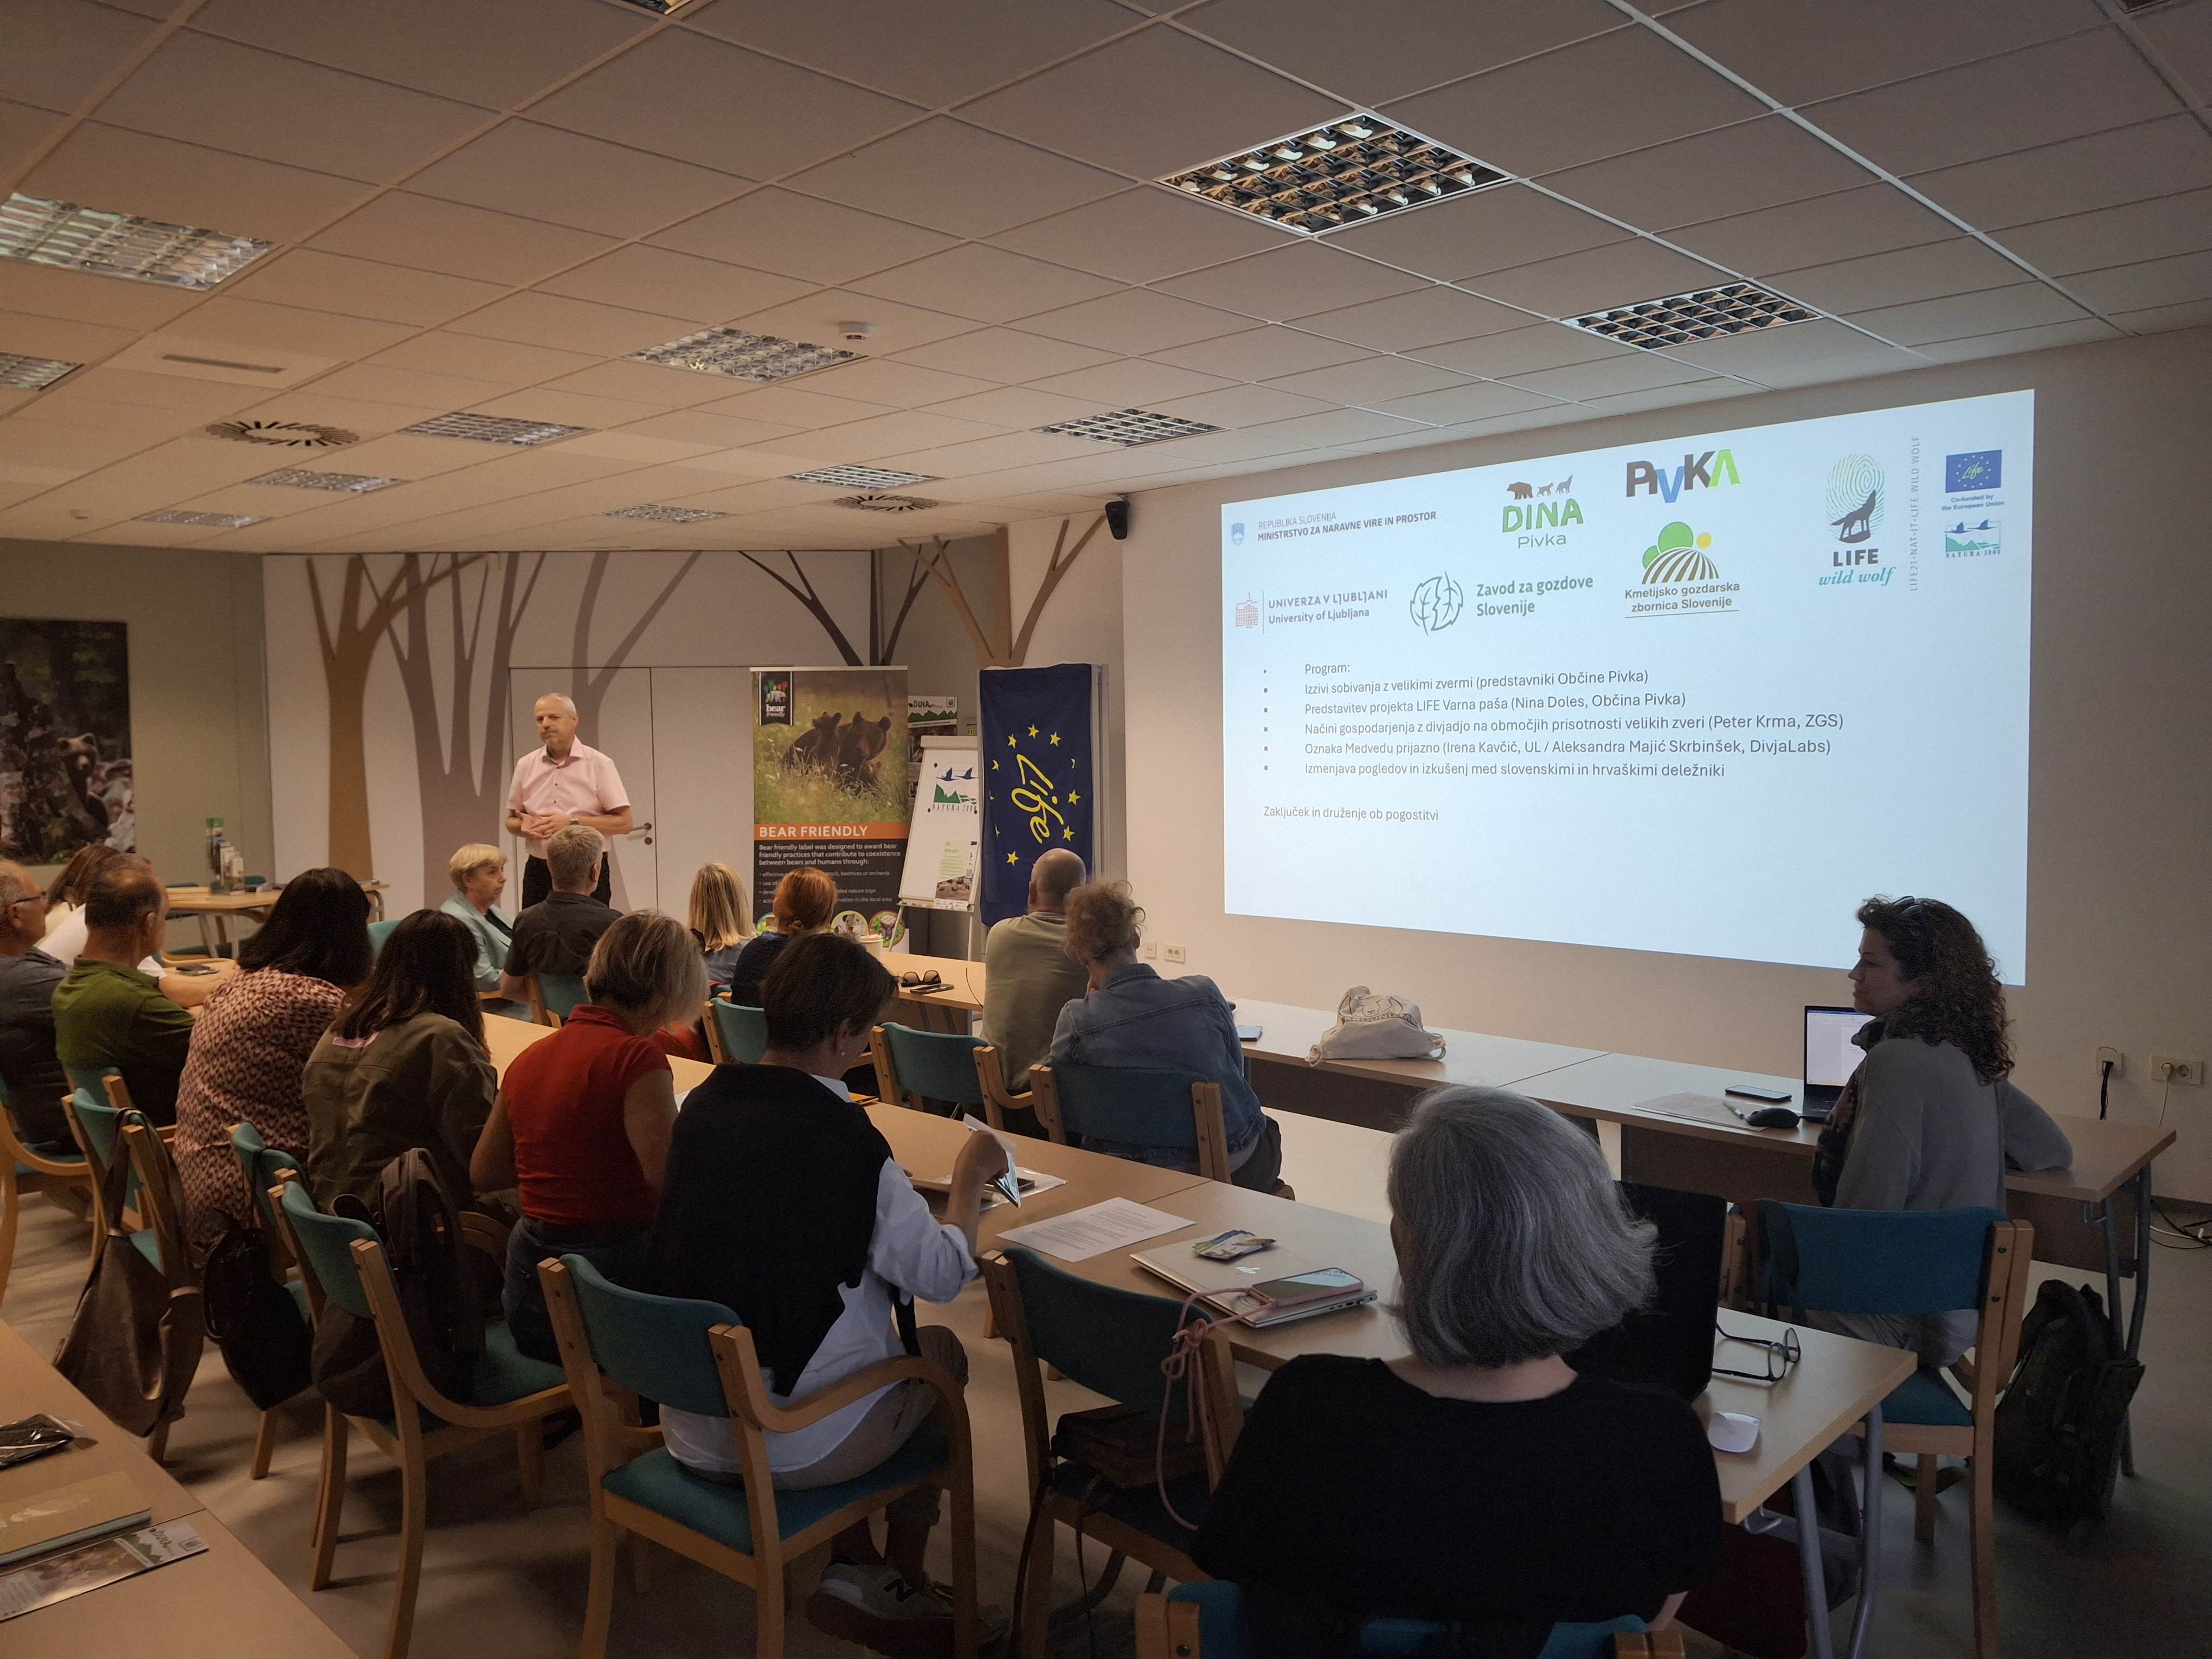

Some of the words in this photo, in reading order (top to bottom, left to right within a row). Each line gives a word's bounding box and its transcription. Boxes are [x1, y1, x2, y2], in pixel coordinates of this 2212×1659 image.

[1962, 462, 1983, 480] Life
[1911, 468, 1919, 493] WILD
[1950, 495, 1984, 503] Co-funded
[1258, 517, 1297, 530] REPUBLIKA
[1298, 512, 1336, 525] SLOVENIJA
[1502, 498, 1584, 533] DINA
[1258, 523, 1309, 541] MINISTRSTVO
[1310, 526, 1321, 535] ZA
[1322, 520, 1361, 533] NARAVNE
[1363, 517, 1383, 529] VIRE
[1385, 517, 1394, 525] IN
[1396, 511, 1436, 524] PROSTOR
[1517, 533, 1566, 549] Pivka
[1833, 548, 1879, 567] LIFE
[1818, 569, 1854, 586] wild
[1858, 566, 1896, 587] wolf
[1477, 580, 1515, 597] Zavod
[1519, 582, 1533, 594] za
[1536, 575, 1593, 596] gozdove
[1625, 587, 1678, 599] Kmetijsko
[1681, 582, 1740, 597] gozdarska
[1268, 595, 1321, 609] UNIVERZA
[1323, 594, 1330, 604] V
[1477, 599, 1535, 617] Slovenije
[1631, 601, 1678, 613] zbornica
[1681, 596, 1732, 609] Slovenije
[1268, 612, 1314, 624] University
[1315, 610, 1326, 621] of
[1328, 608, 1369, 622] Ljubljana
[1305, 664, 1350, 677] Program:
[1305, 683, 1329, 695] Izzivi
[1331, 681, 1381, 695] sobivanja
[1383, 683, 1389, 692] z
[1391, 678, 1433, 691] velikimi
[1435, 676, 1473, 690] zvermi
[1476, 673, 1554, 690] (predstavniki
[1558, 671, 1605, 685] Občine
[1609, 669, 1648, 684] Pivka)
[766, 704, 786, 712] bear
[1305, 703, 1367, 715] Predstavitev
[1369, 701, 1413, 715] projekta
[1417, 699, 1440, 711] LIFE
[1442, 699, 1476, 711] Varna
[1479, 697, 1508, 712] paša
[1511, 697, 1544, 711] (Nina
[1548, 696, 1588, 709] Doles,
[1592, 693, 1640, 707] Občina
[1645, 692, 1686, 708] Pivka)
[1305, 723, 1337, 734] Načini
[1339, 721, 1415, 736] gospodarjenja
[1417, 723, 1423, 732] z
[1425, 720, 1470, 735] divjadjo
[1473, 722, 1488, 731] na
[1490, 718, 1548, 734] območjih
[1552, 717, 1622, 733] prisotnosti
[1625, 716, 1669, 729] velikih
[1671, 716, 1705, 729] zveri
[1708, 715, 1752, 731] (Peter
[1756, 715, 1801, 730] Krma,
[1805, 713, 1843, 730] ZGS)
[1304, 743, 1342, 754] Oznaka
[1345, 743, 1393, 754] Medvedu
[1396, 742, 1440, 756] prijazno
[1443, 742, 1476, 755] (Irena
[1478, 741, 1521, 755] Kavčič,
[1525, 741, 1541, 753] UL
[1544, 741, 1549, 753] /
[1552, 740, 1625, 753] Aleksandra
[1629, 740, 1666, 755] Majić
[1669, 739, 1745, 755] Skrbinšek,
[1750, 739, 1830, 756] DivjaLabs)
[1305, 763, 1356, 776] Izmenjava
[1359, 763, 1407, 776] pogledov
[1410, 765, 1419, 774] in
[1422, 762, 1468, 777] izkušenj
[1471, 763, 1497, 775] med
[1501, 763, 1574, 775] slovenskimi
[1578, 763, 1589, 775] in
[1592, 763, 1657, 776] hrvaškimi
[1661, 763, 1725, 777] deležniki
[1011, 753, 1064, 844] Life
[931, 803, 960, 812] NATURA
[1263, 806, 1310, 819] Zaključek
[1312, 809, 1321, 818] in
[1323, 807, 1367, 821] druženje
[1369, 808, 1383, 819] ob
[1386, 809, 1438, 822] pogostitvi
[759, 826, 796, 837] BEAR
[800, 826, 868, 837] FRIENDLY
